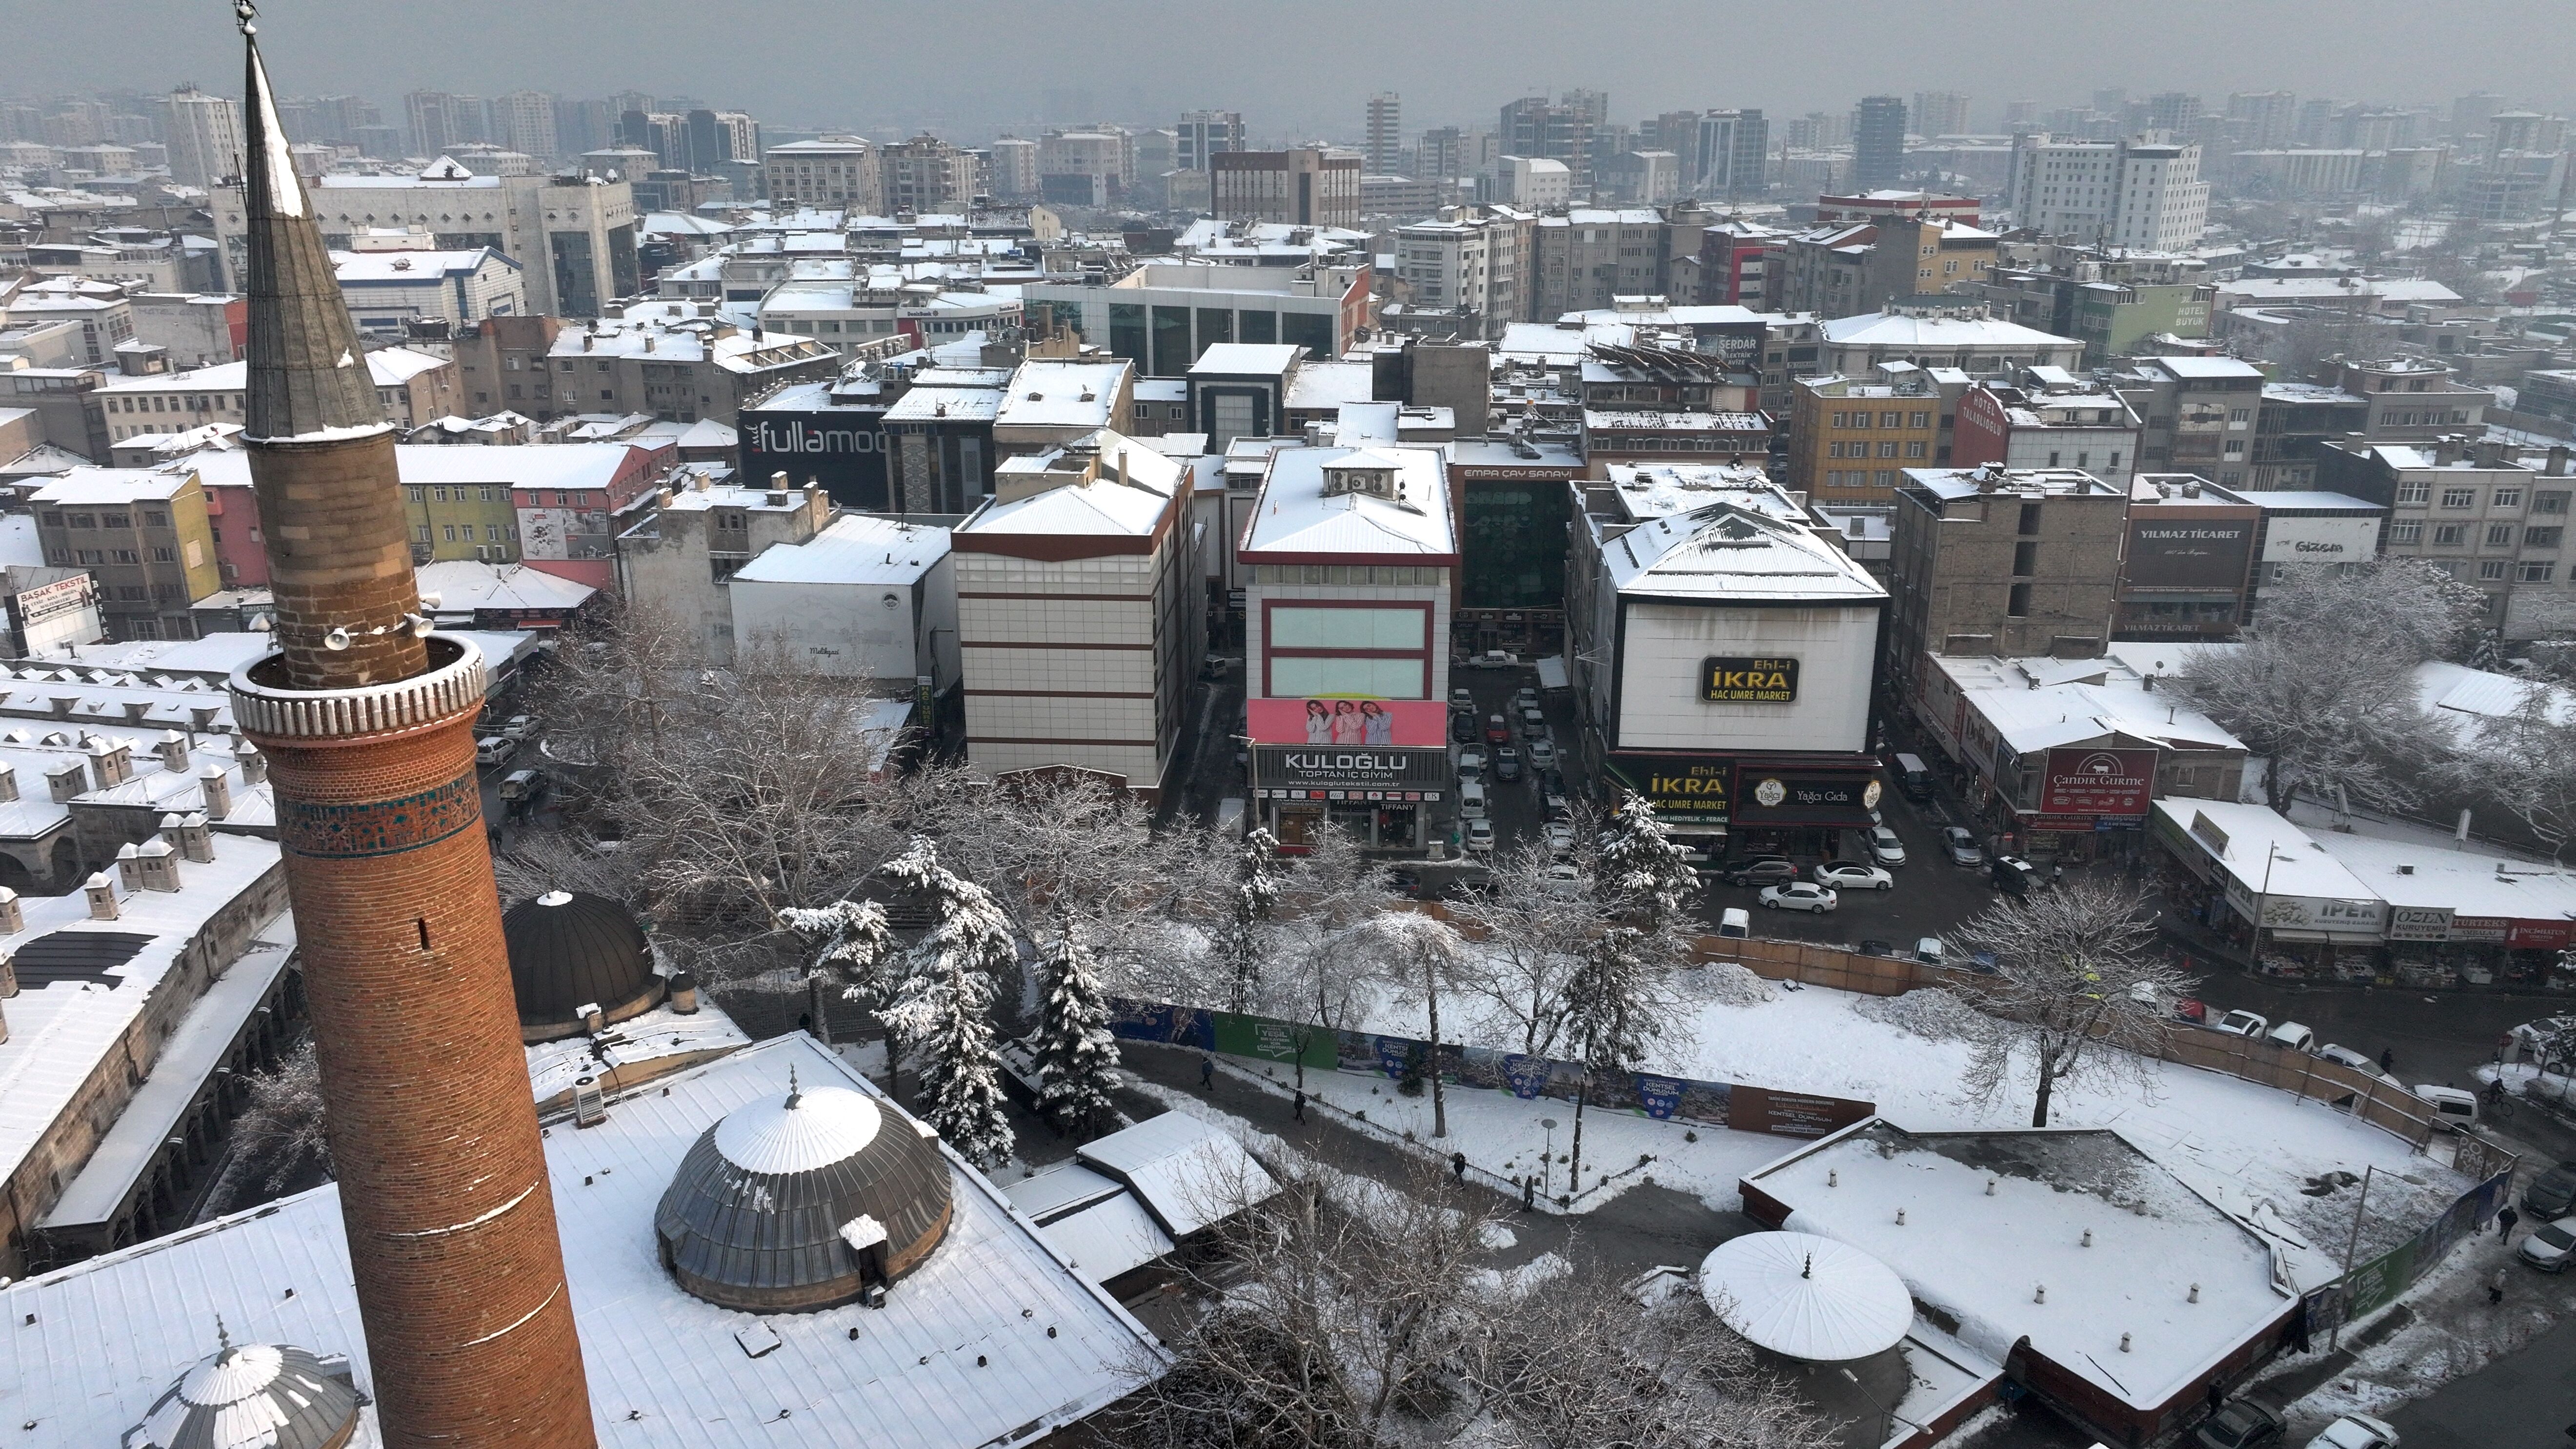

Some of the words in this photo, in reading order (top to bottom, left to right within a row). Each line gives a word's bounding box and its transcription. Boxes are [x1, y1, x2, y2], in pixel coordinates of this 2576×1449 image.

[2178, 307, 2204, 315] HOTEL
[1720, 339, 1756, 349] SERDAR
[1974, 395, 1994, 416] HOTEL
[1502, 470, 1526, 478] ÇAY
[1529, 469, 1572, 478] SANAYİ
[2190, 529, 2240, 539] TİCARET
[21, 586, 52, 602] BAŞAK
[54, 576, 87, 590] TEKSTİL
[2161, 622, 2200, 631] TİCARET
[810, 647, 839, 658] Melikgazi
[1754, 659, 1791, 670] Ehl-i
[1713, 666, 1789, 689] İKRA
[1711, 689, 1729, 699] HAC
[1731, 690, 1754, 700] UMRE
[1756, 691, 1791, 701] MARKET
[1286, 752, 1406, 770] KULOĞLU
[1348, 769, 1358, 779] İÇ
[1361, 770, 1393, 779] GİYİM
[1691, 766, 1727, 776] Ehl-i
[1651, 772, 1726, 795] İKRA
[1797, 791, 1822, 804] Yağcı
[1825, 791, 1848, 802] Gıda
[1669, 800, 1691, 809] UMRE
[1693, 801, 1727, 810] MARKET
[2397, 909, 2450, 924] ÖZEN
[2395, 924, 2447, 932] KURUYEMİŞ
[1385, 1043, 1409, 1051] KENTSE
[1646, 1082, 1676, 1090] KENTSEL
[1768, 1110, 1796, 1118] KENTSEL
